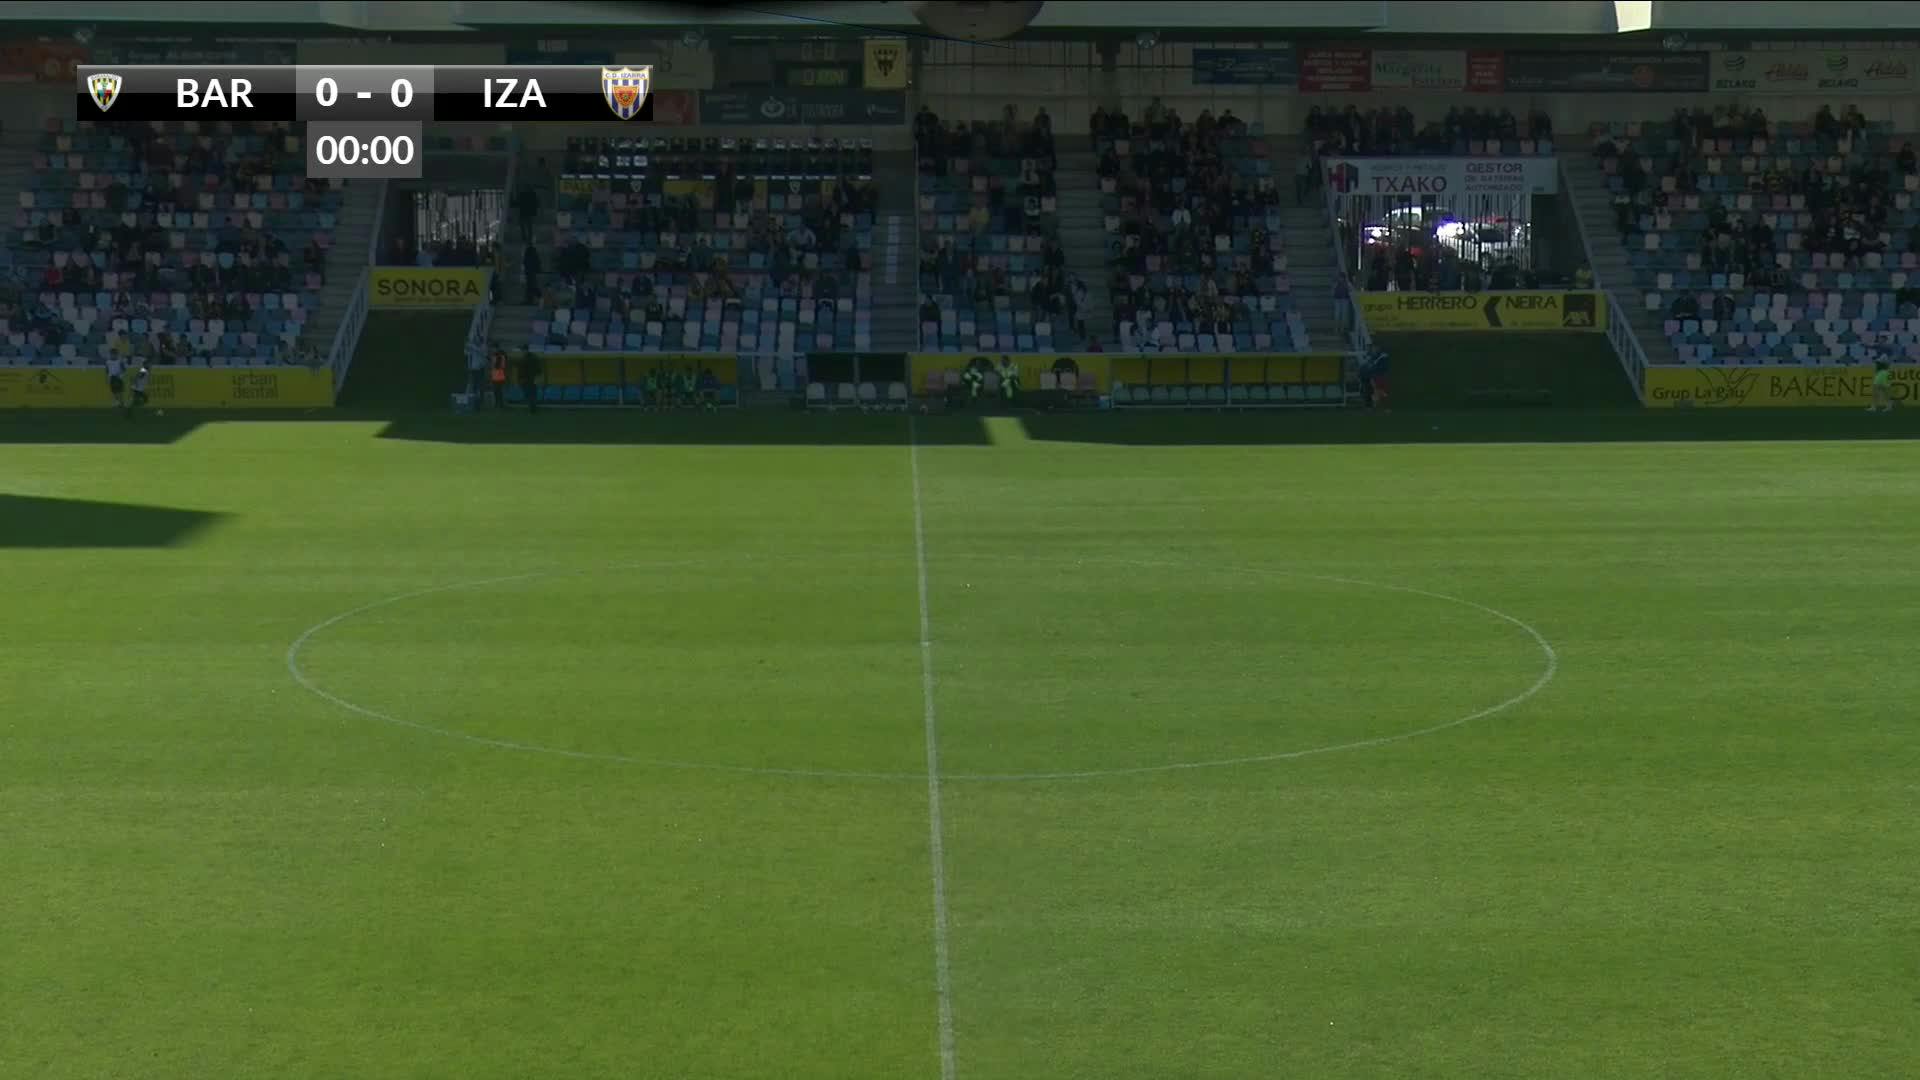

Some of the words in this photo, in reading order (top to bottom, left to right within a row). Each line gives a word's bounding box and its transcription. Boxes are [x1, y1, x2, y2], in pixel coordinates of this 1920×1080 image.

[1465, 162, 1523, 174] GESTOR
[1372, 176, 1448, 193] TXAKO
[378, 278, 480, 296] SONORA
[1397, 295, 1478, 311] HERRERO
[1504, 295, 1558, 310] NEIRA
[231, 369, 273, 385] urban
[231, 383, 279, 400] dental
[1652, 386, 1690, 402] Grup
[1695, 386, 1712, 400] La
